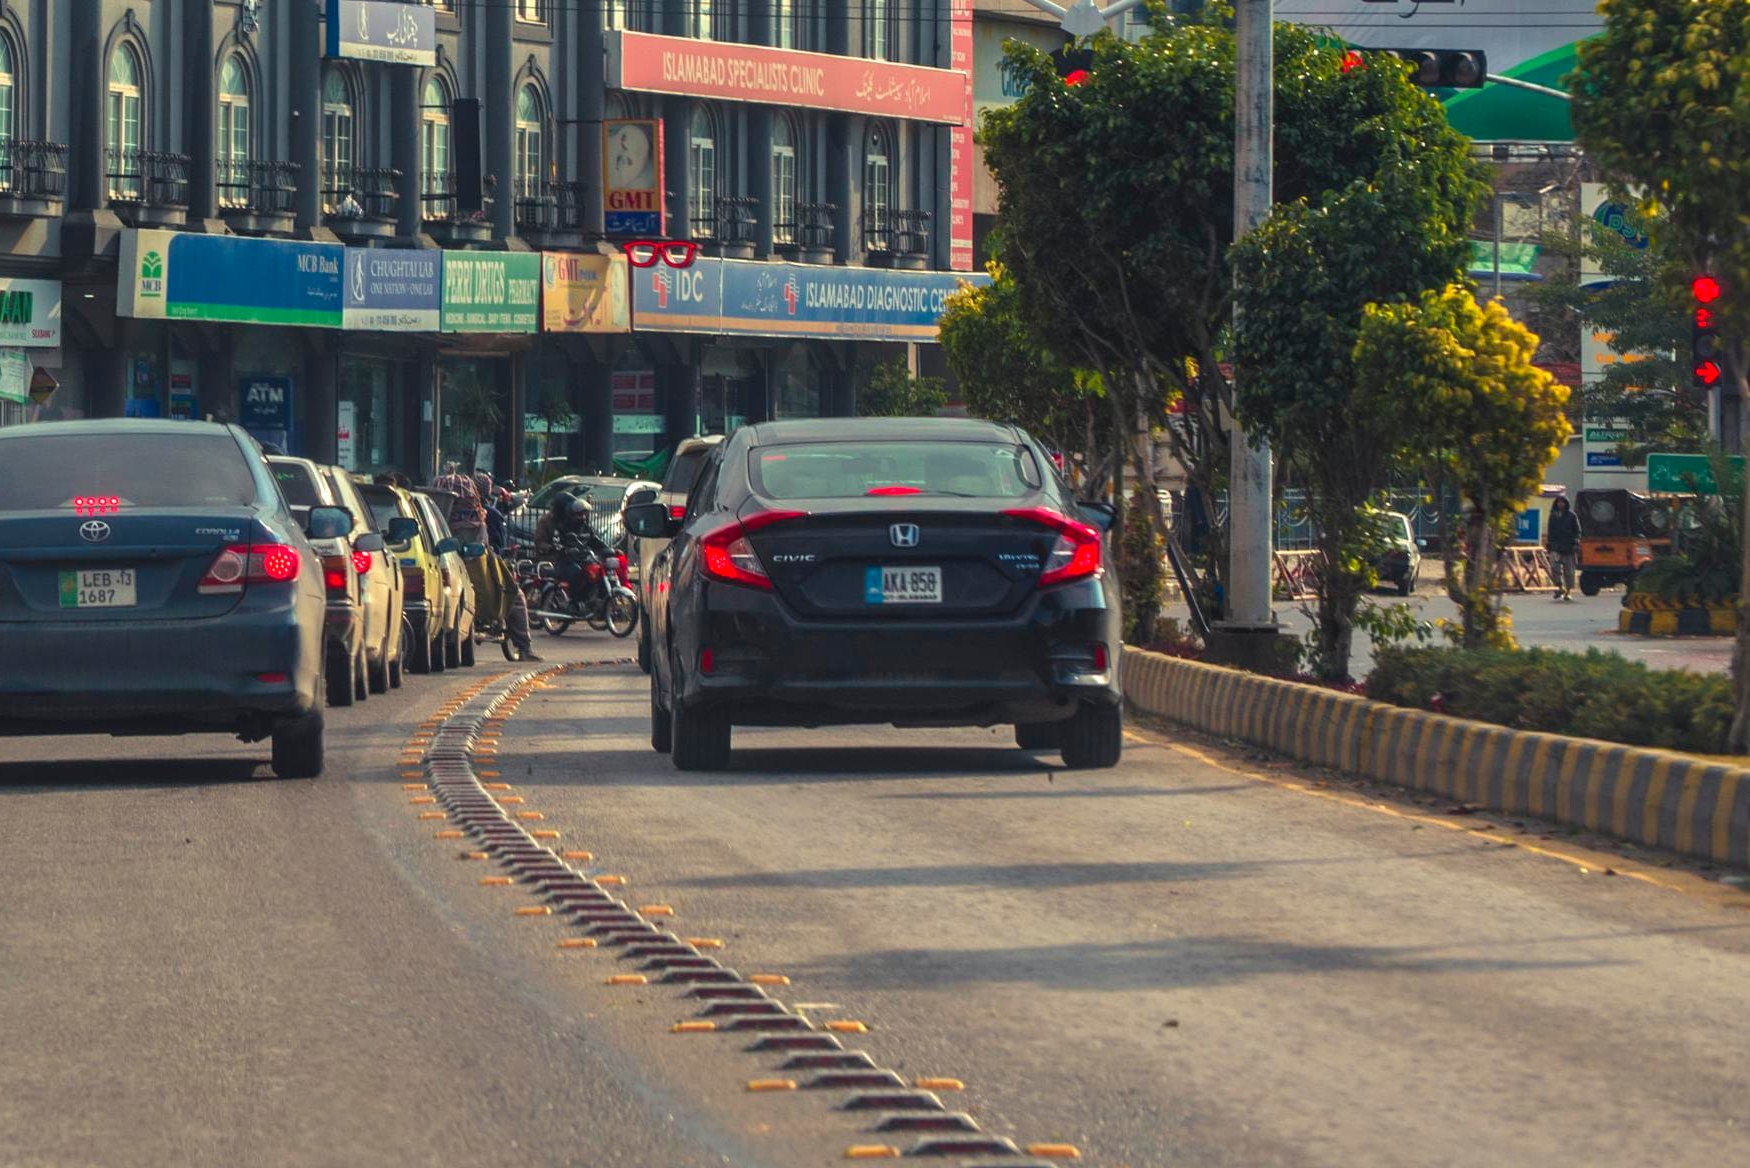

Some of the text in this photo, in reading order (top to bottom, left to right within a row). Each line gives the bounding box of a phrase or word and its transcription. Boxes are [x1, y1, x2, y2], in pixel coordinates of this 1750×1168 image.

[663, 51, 825, 96] ISLAMABAD SPECIALISTS CLINIC
[608, 191, 655, 210] GMT
[297, 254, 339, 275] MCB Bank
[370, 260, 434, 279] CHUGHTAI LAB
[558, 258, 579, 282] GMT
[141, 279, 162, 293] MCB
[474, 261, 506, 305] DRUGS
[508, 279, 536, 305] PHARMACY
[676, 269, 704, 304] IDC
[806, 281, 864, 310] ISLAMABAD
[867, 285, 928, 312] DIAGNOSTIC
[246, 388, 284, 403] ATM
[195, 527, 240, 535] COROLLA
[773, 554, 816, 563] CIVIC
[82, 573, 112, 588] LEB
[79, 589, 116, 605] 1687
